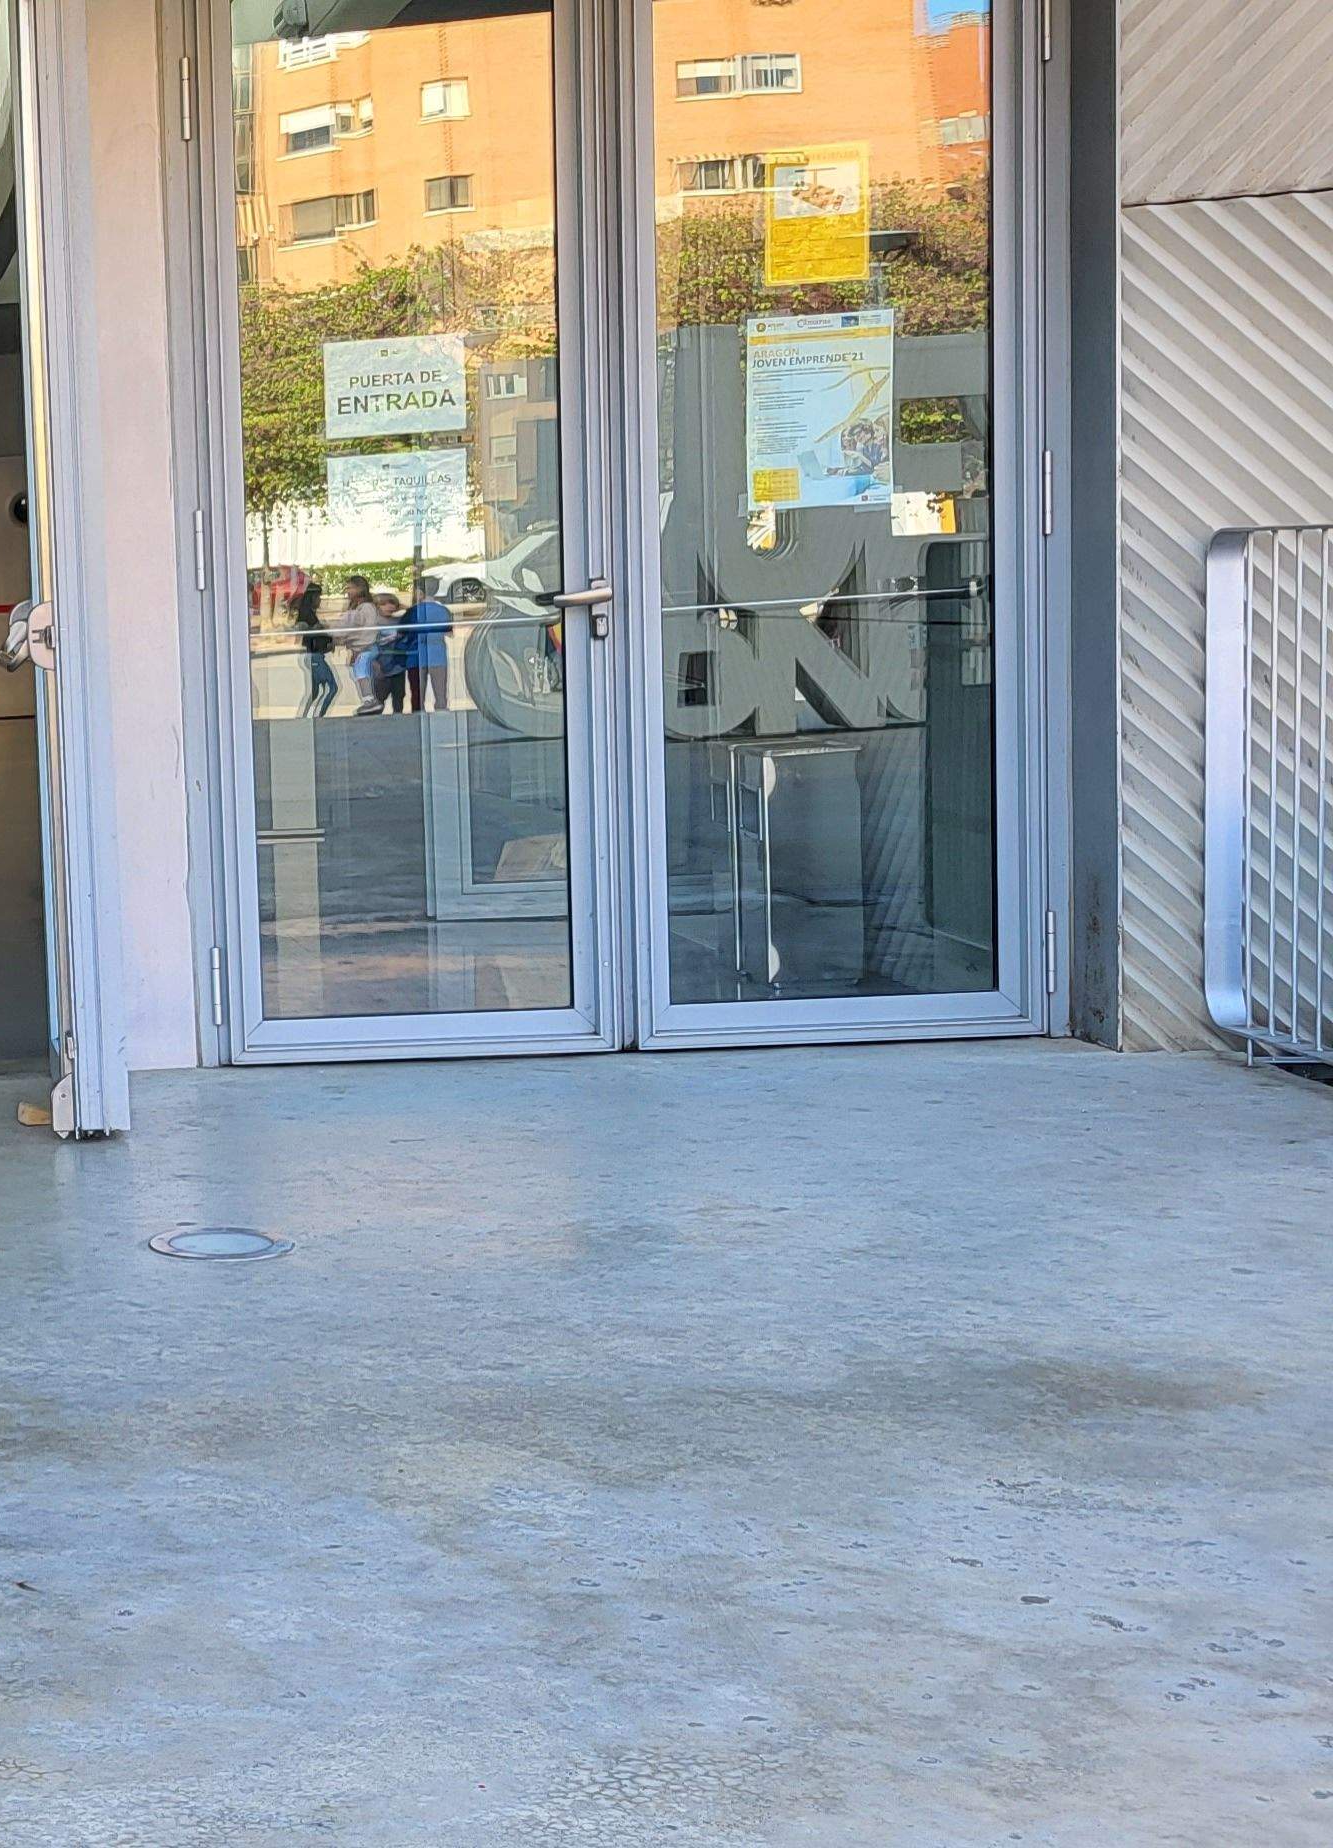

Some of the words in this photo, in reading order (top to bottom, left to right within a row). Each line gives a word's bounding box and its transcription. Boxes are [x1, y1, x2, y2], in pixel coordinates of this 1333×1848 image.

[752, 357, 789, 368] JOVEN
[349, 373, 415, 389] PUERTA
[420, 370, 441, 383] DE
[337, 389, 456, 415] ENTRADA
